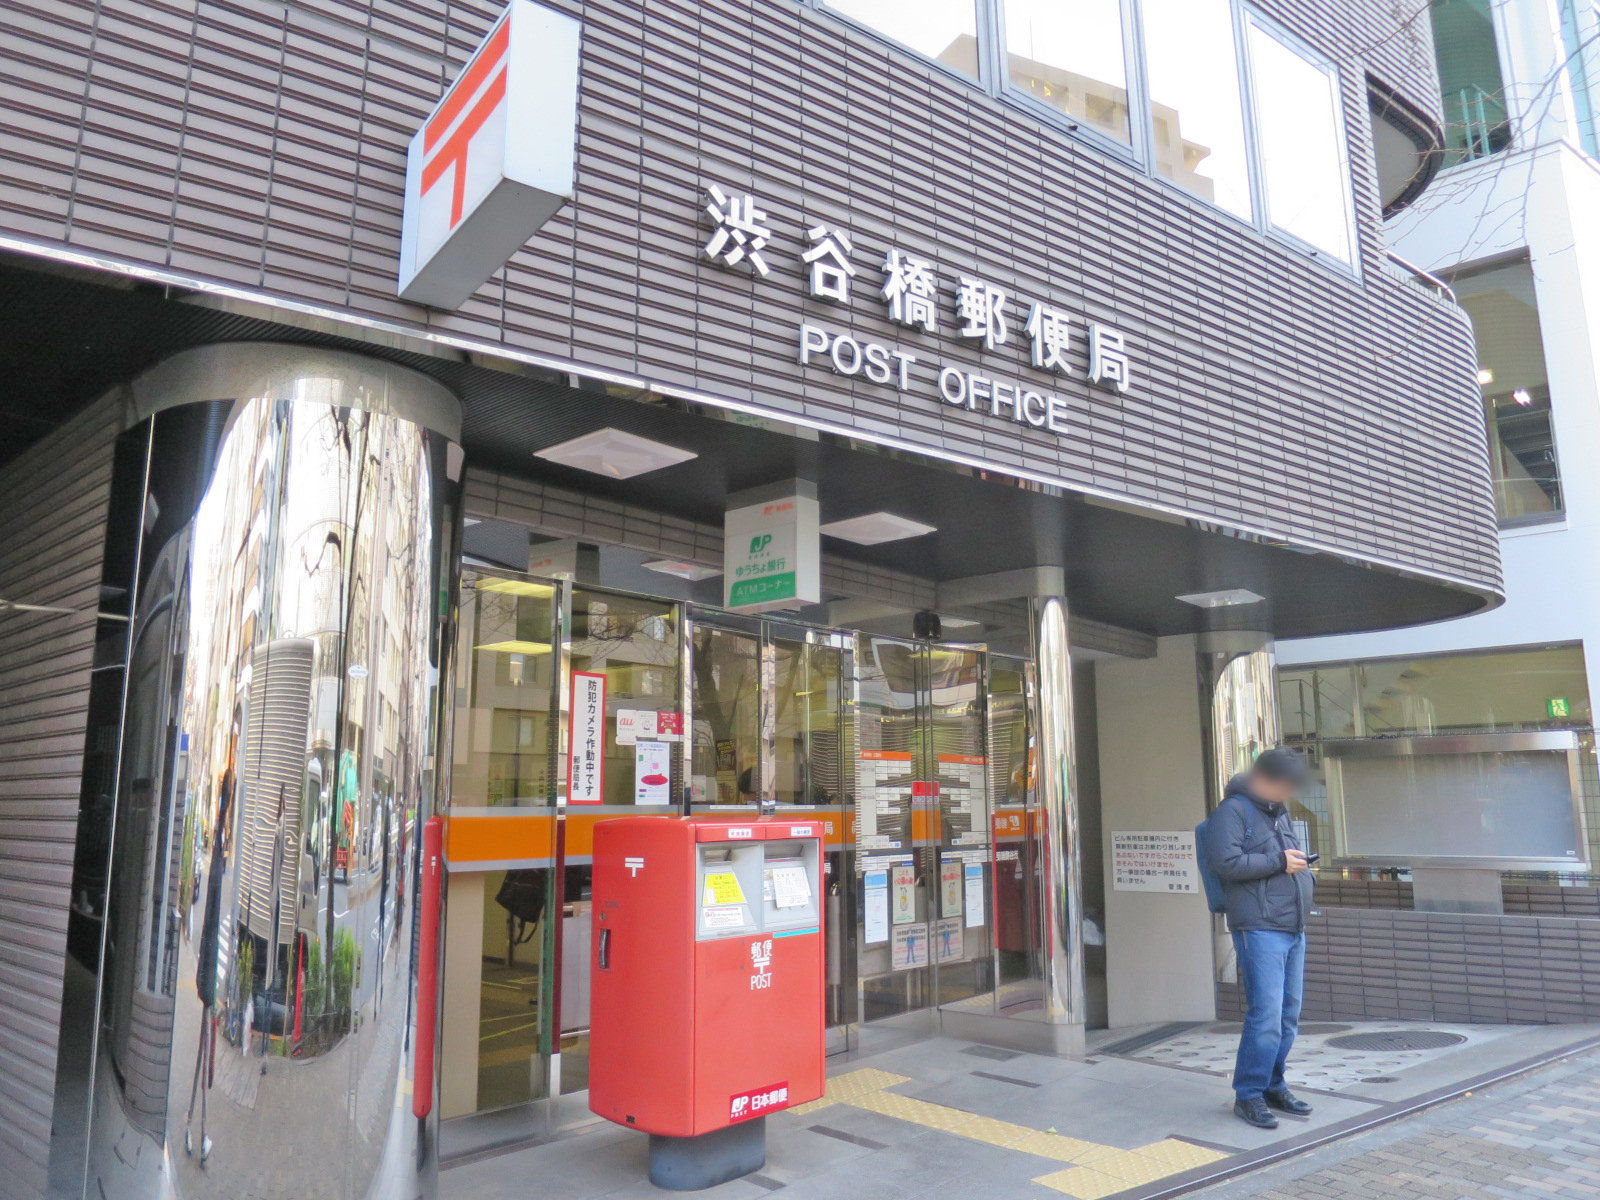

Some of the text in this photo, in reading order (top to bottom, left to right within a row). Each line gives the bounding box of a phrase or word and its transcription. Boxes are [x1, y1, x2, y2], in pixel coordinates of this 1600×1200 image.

[703, 183, 1130, 394] 渋谷橋郵便局
[799, 323, 1069, 434] POST OFFICE
[750, 534, 772, 553] JP
[736, 557, 785, 577] ゆうちょ銀行
[736, 579, 791, 597] ATMコーナー
[585, 680, 597, 797] 防犯カメラ作動中です
[572, 755, 580, 791] 郵便局長
[1115, 852, 1193, 860] あぶないですからこのなかで
[1115, 860, 1175, 868] あそんではいけません
[751, 939, 772, 960] 郵便
[751, 972, 772, 991] POST
[731, 1096, 749, 1113] JP
[751, 1087, 788, 1111] 日本郵便
